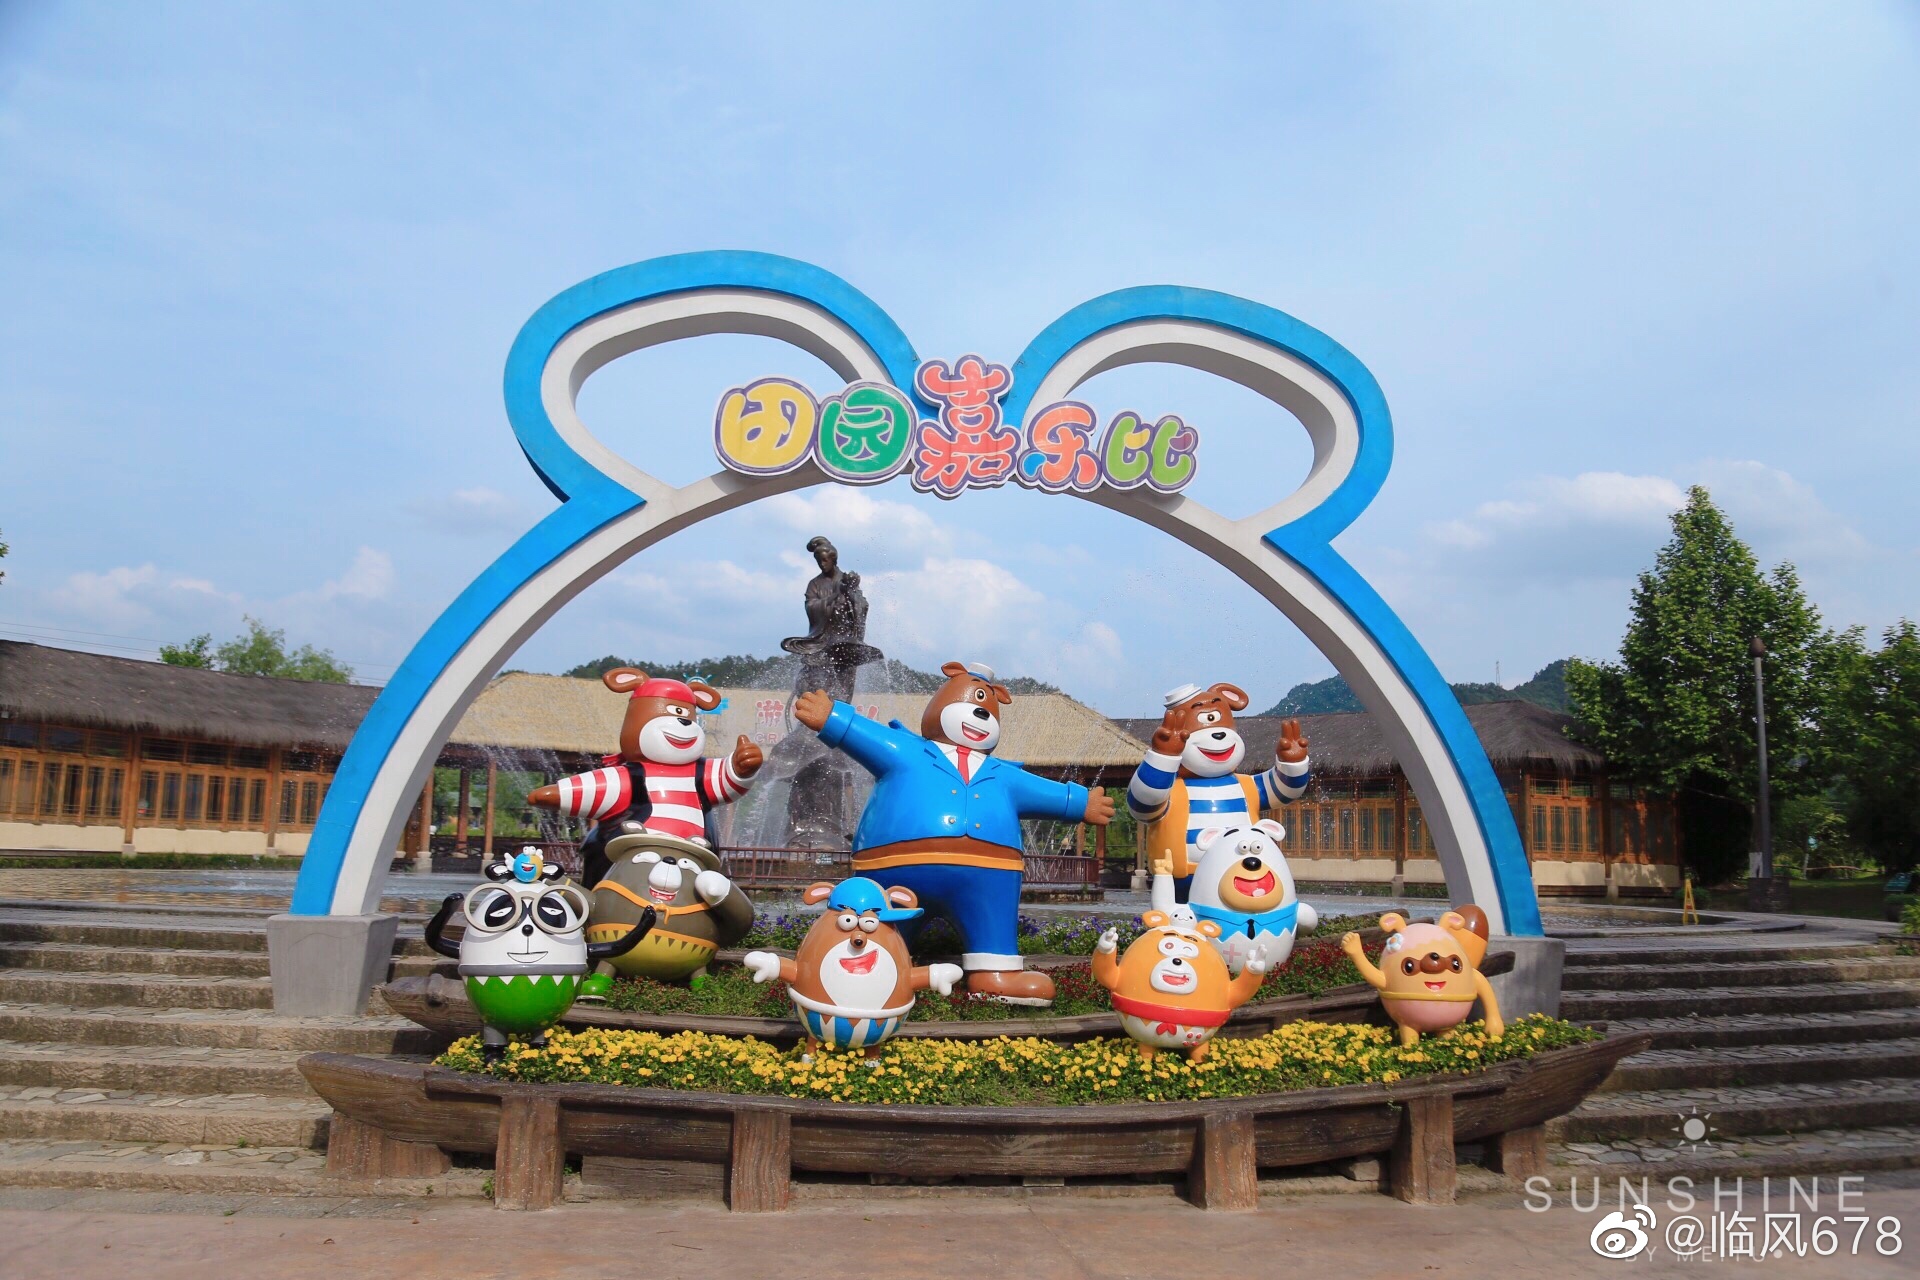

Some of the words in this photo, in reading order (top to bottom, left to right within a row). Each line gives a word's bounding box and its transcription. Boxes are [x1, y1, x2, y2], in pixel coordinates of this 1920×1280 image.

[715, 356, 1198, 496] 田园嘉乐比
